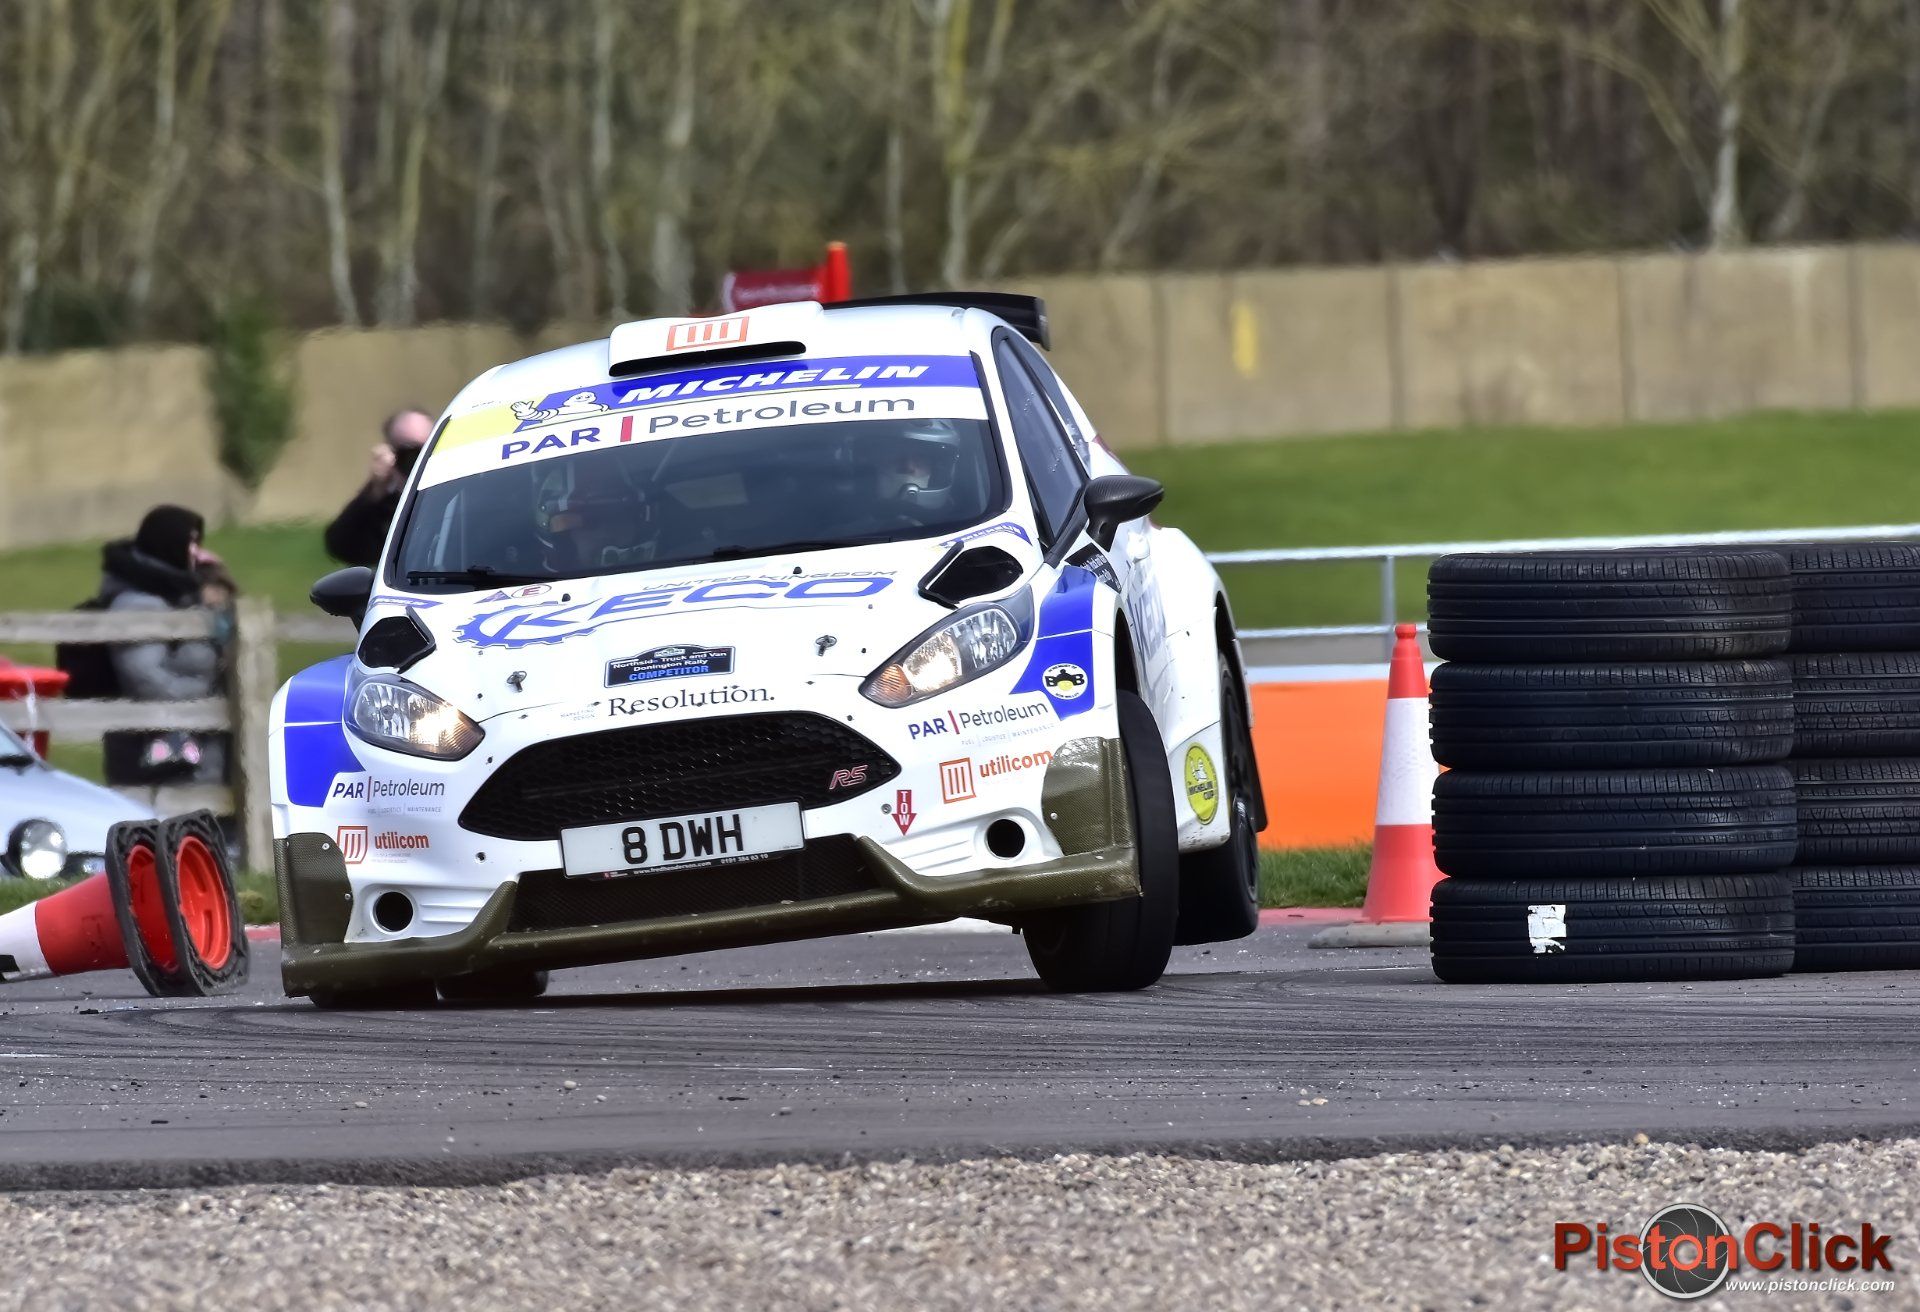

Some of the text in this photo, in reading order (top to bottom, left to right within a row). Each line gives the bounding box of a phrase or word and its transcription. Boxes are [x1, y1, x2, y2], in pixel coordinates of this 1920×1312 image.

[618, 365, 930, 405] MICHELIN
[501, 398, 915, 460] PAR Petroleum
[643, 570, 899, 591] UNITED KINGDOM
[633, 658, 709, 672] Donington Rally
[661, 655, 688, 663] Truck
[688, 652, 707, 660] and
[628, 665, 709, 681] COMPETITOR
[608, 686, 775, 717] Resolution.
[908, 702, 1049, 740] PAR Petroleum
[829, 764, 869, 790] RS
[979, 750, 1054, 778] utilicom
[332, 778, 445, 799] PAR Petroleum
[899, 790, 911, 826] TOW
[374, 831, 430, 850] utilicom
[621, 813, 744, 865] 8 DWH
